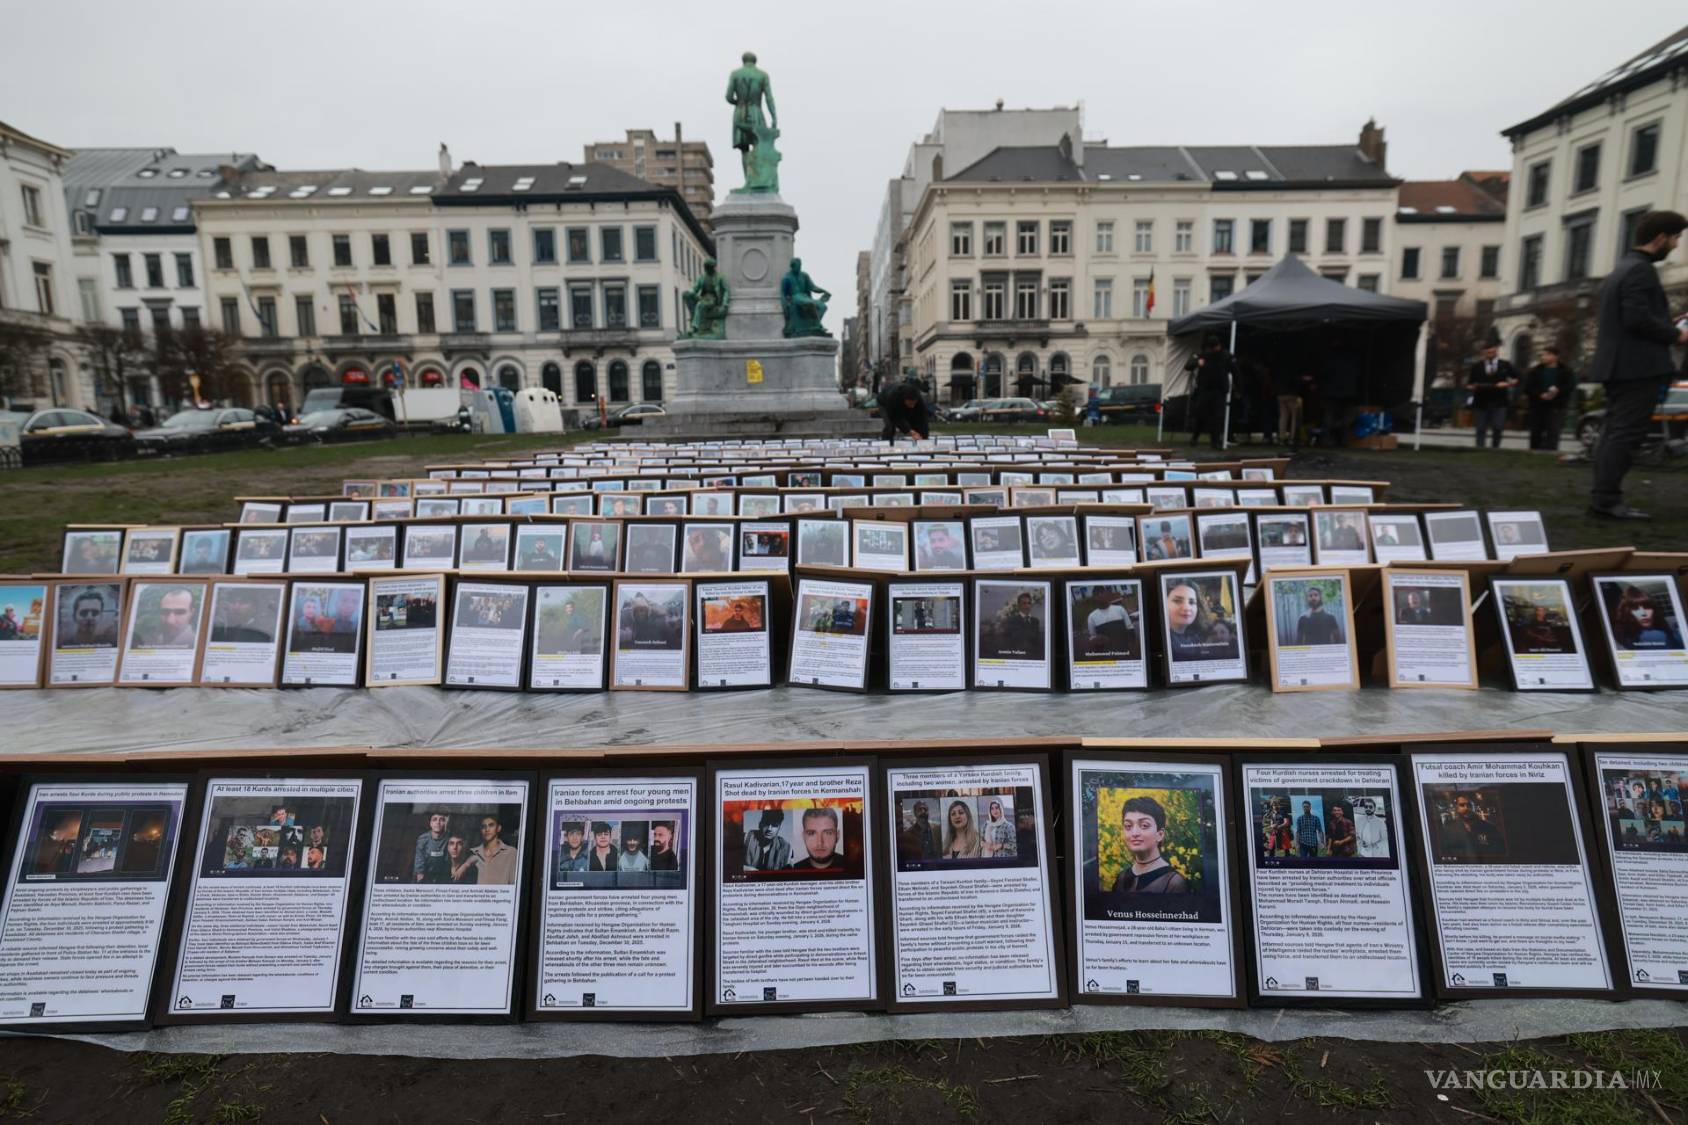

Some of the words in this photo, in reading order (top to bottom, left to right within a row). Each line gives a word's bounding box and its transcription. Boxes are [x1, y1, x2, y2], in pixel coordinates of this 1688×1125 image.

[623, 798, 654, 806] ongoing
[656, 798, 687, 806] protests
[1135, 911, 1199, 919] Hosseinnezhad
